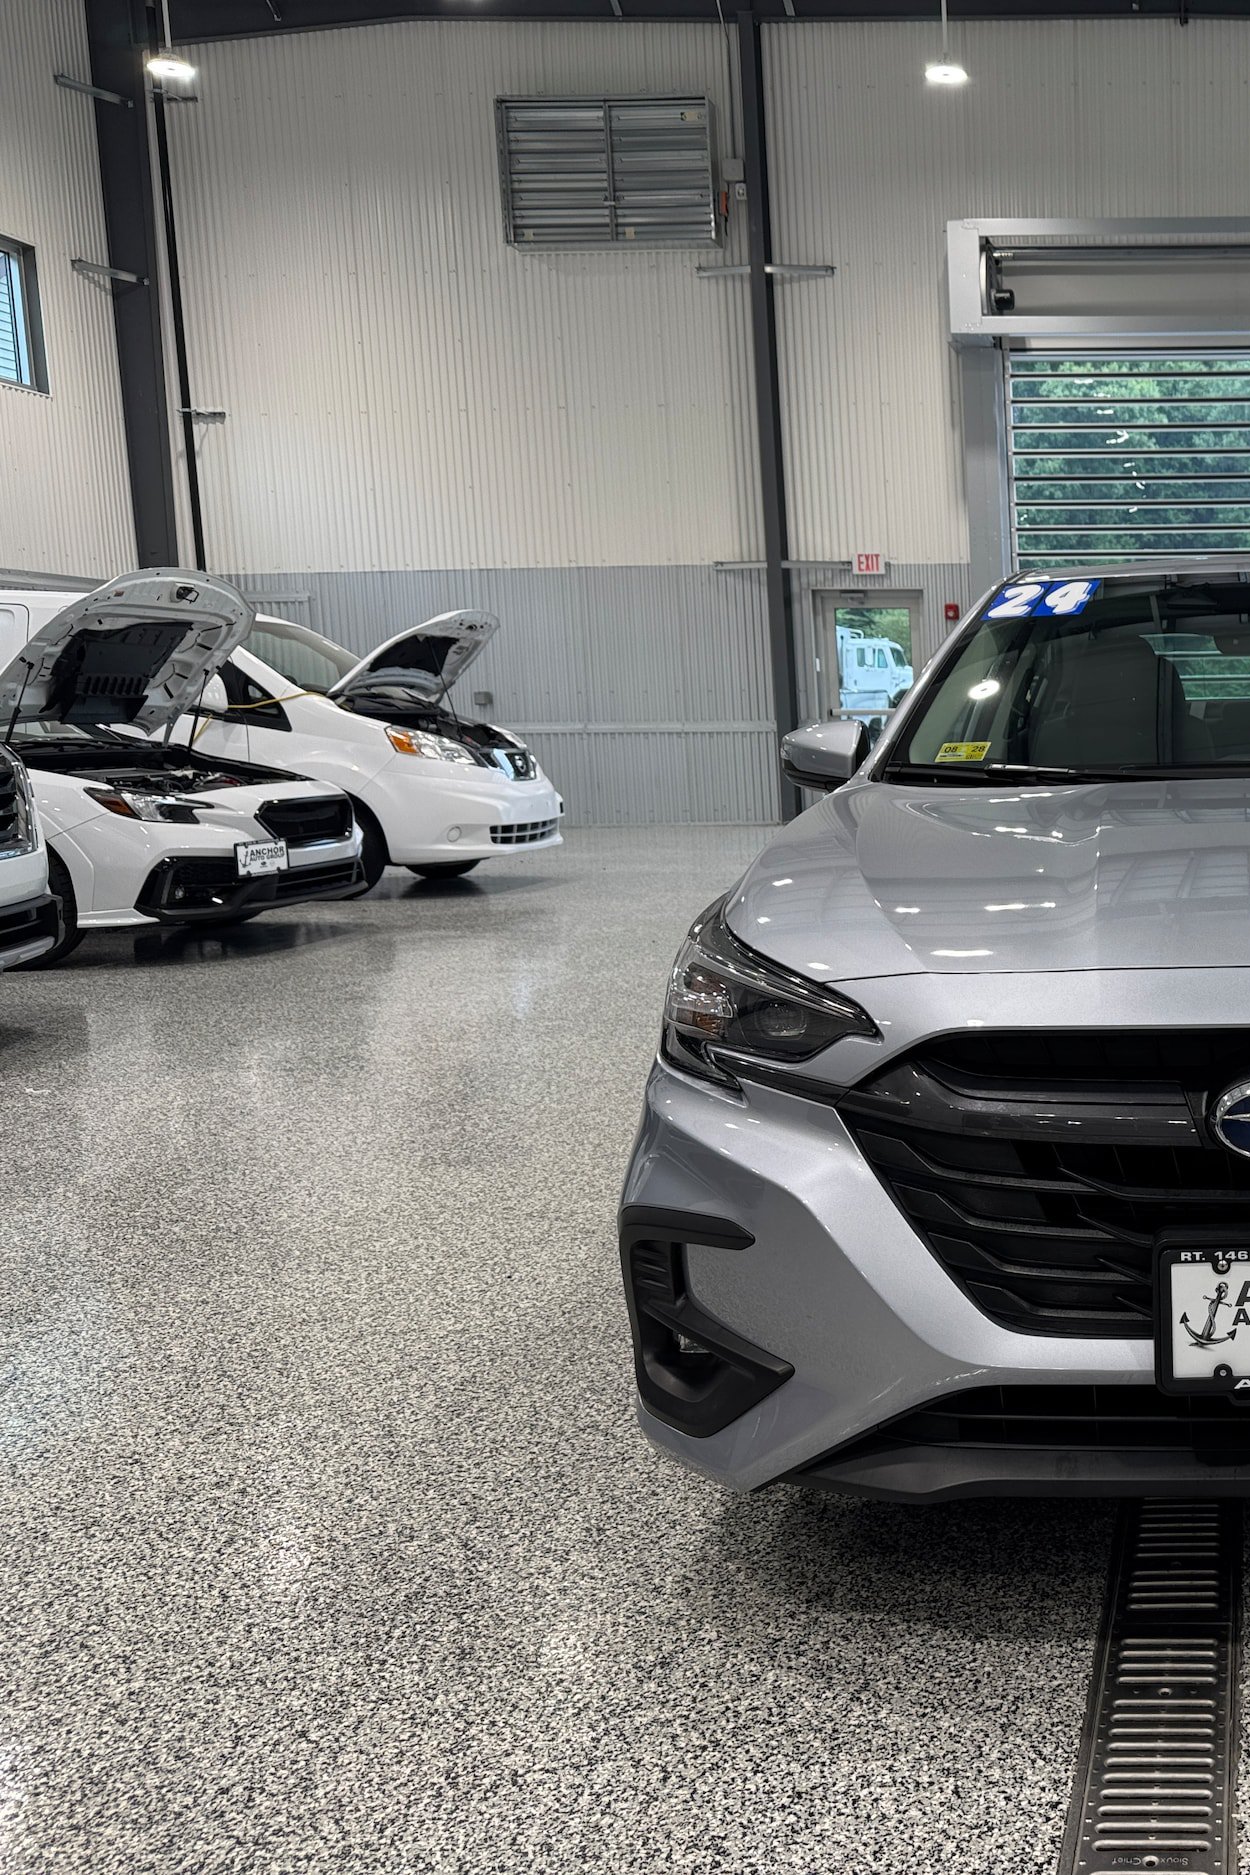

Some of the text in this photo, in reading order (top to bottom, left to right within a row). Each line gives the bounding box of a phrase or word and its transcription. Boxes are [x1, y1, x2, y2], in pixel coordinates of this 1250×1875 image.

[857, 553, 881, 573] EXIT
[987, 581, 1093, 619] 24
[944, 745, 958, 753] 08
[249, 845, 285, 857] ANCHOR
[1180, 1250, 1206, 1261] RT.
[1213, 1250, 1249, 1261] 146
[1160, 1856, 1189, 1866] Sioux
